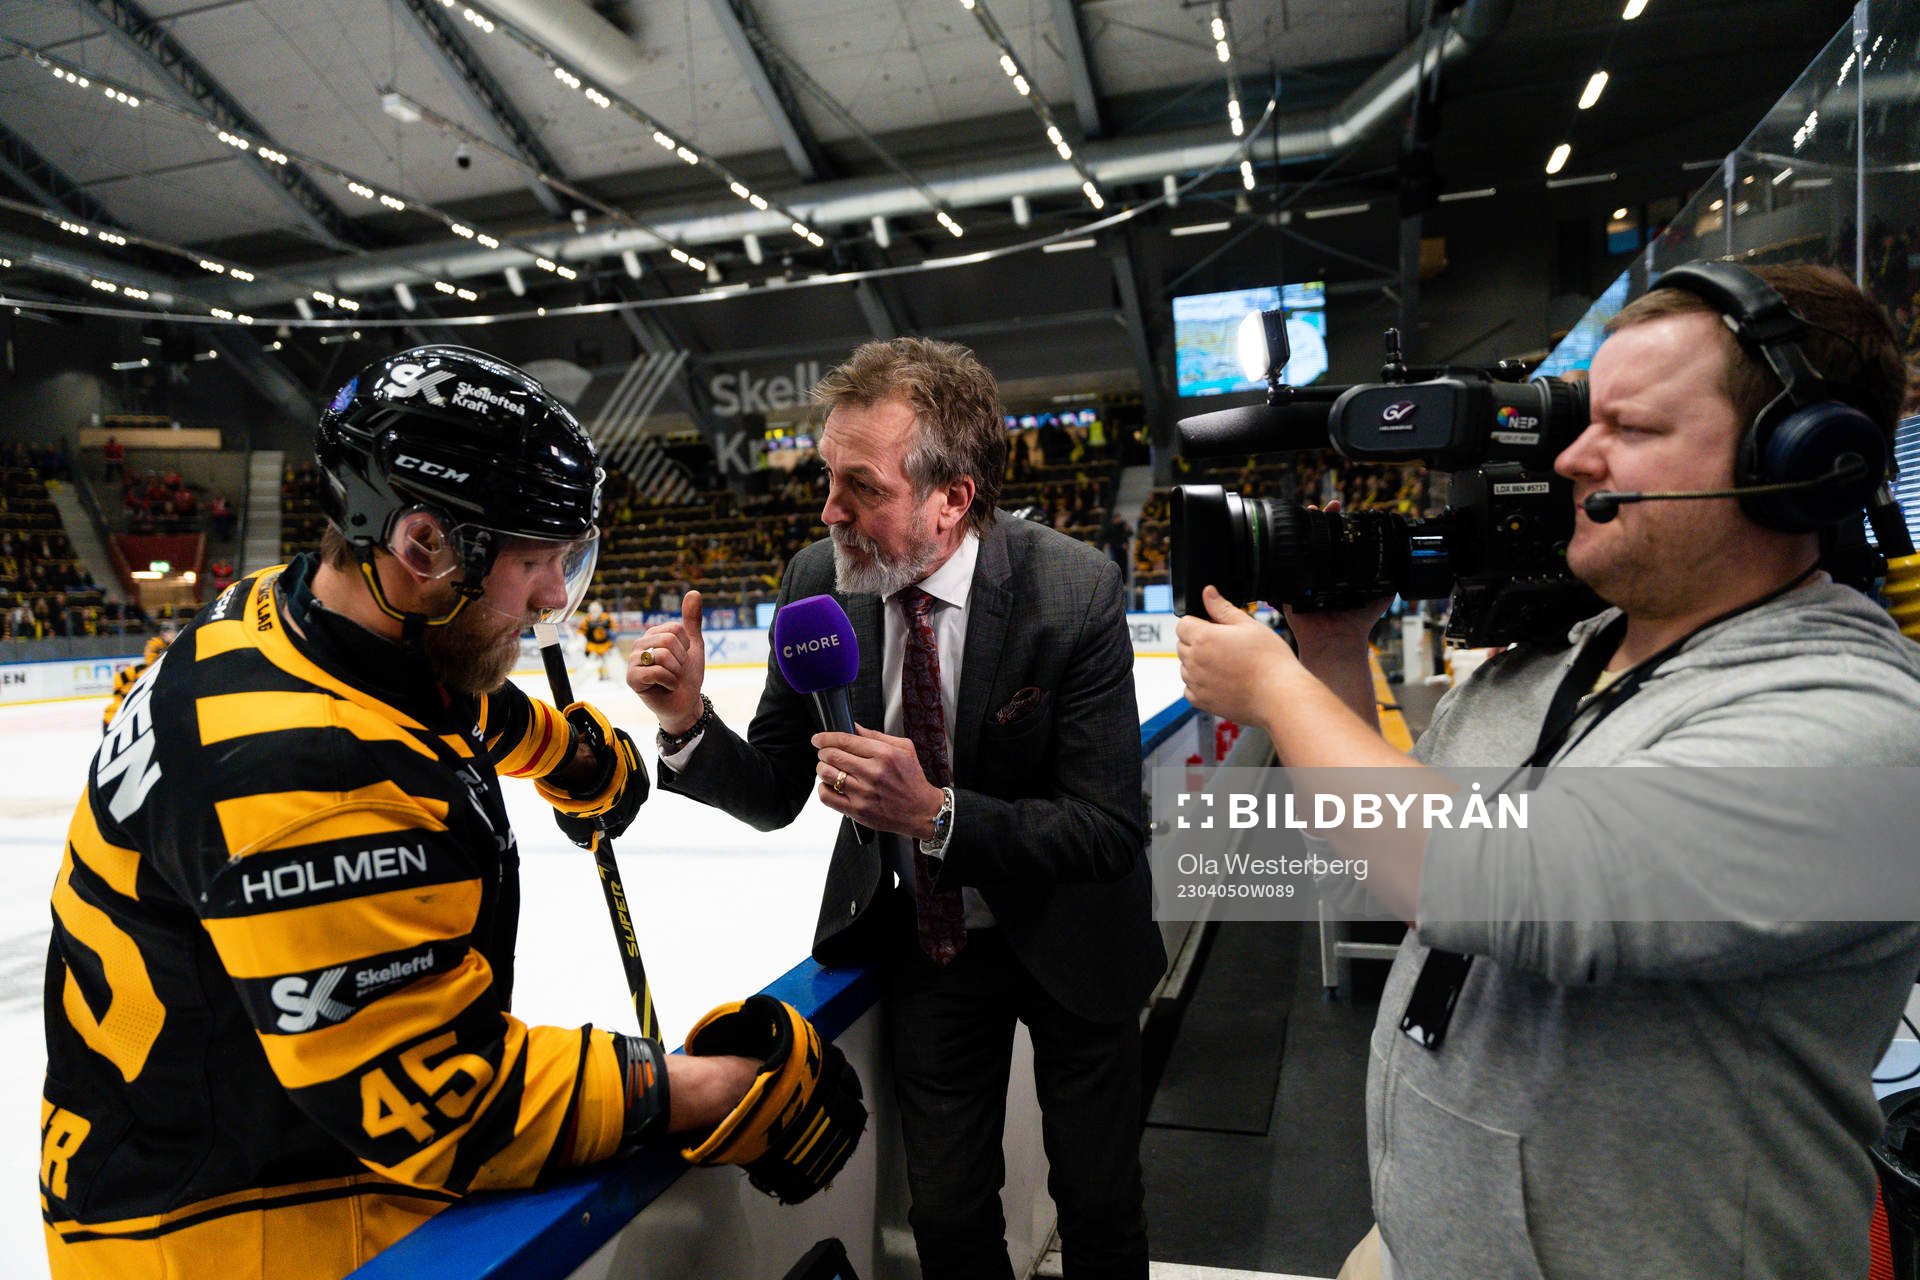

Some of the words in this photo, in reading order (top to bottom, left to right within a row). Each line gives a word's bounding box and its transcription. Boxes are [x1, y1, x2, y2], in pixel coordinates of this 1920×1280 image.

[452, 394, 489, 415] Kraft
[456, 381, 526, 416] Skellefteå
[1508, 416, 1538, 429] NEP
[394, 454, 470, 484] CCM
[796, 634, 840, 655] MORE
[242, 844, 428, 903] HOLMEN
[611, 880, 639, 958] SUPER
[360, 1030, 495, 1143] 45
